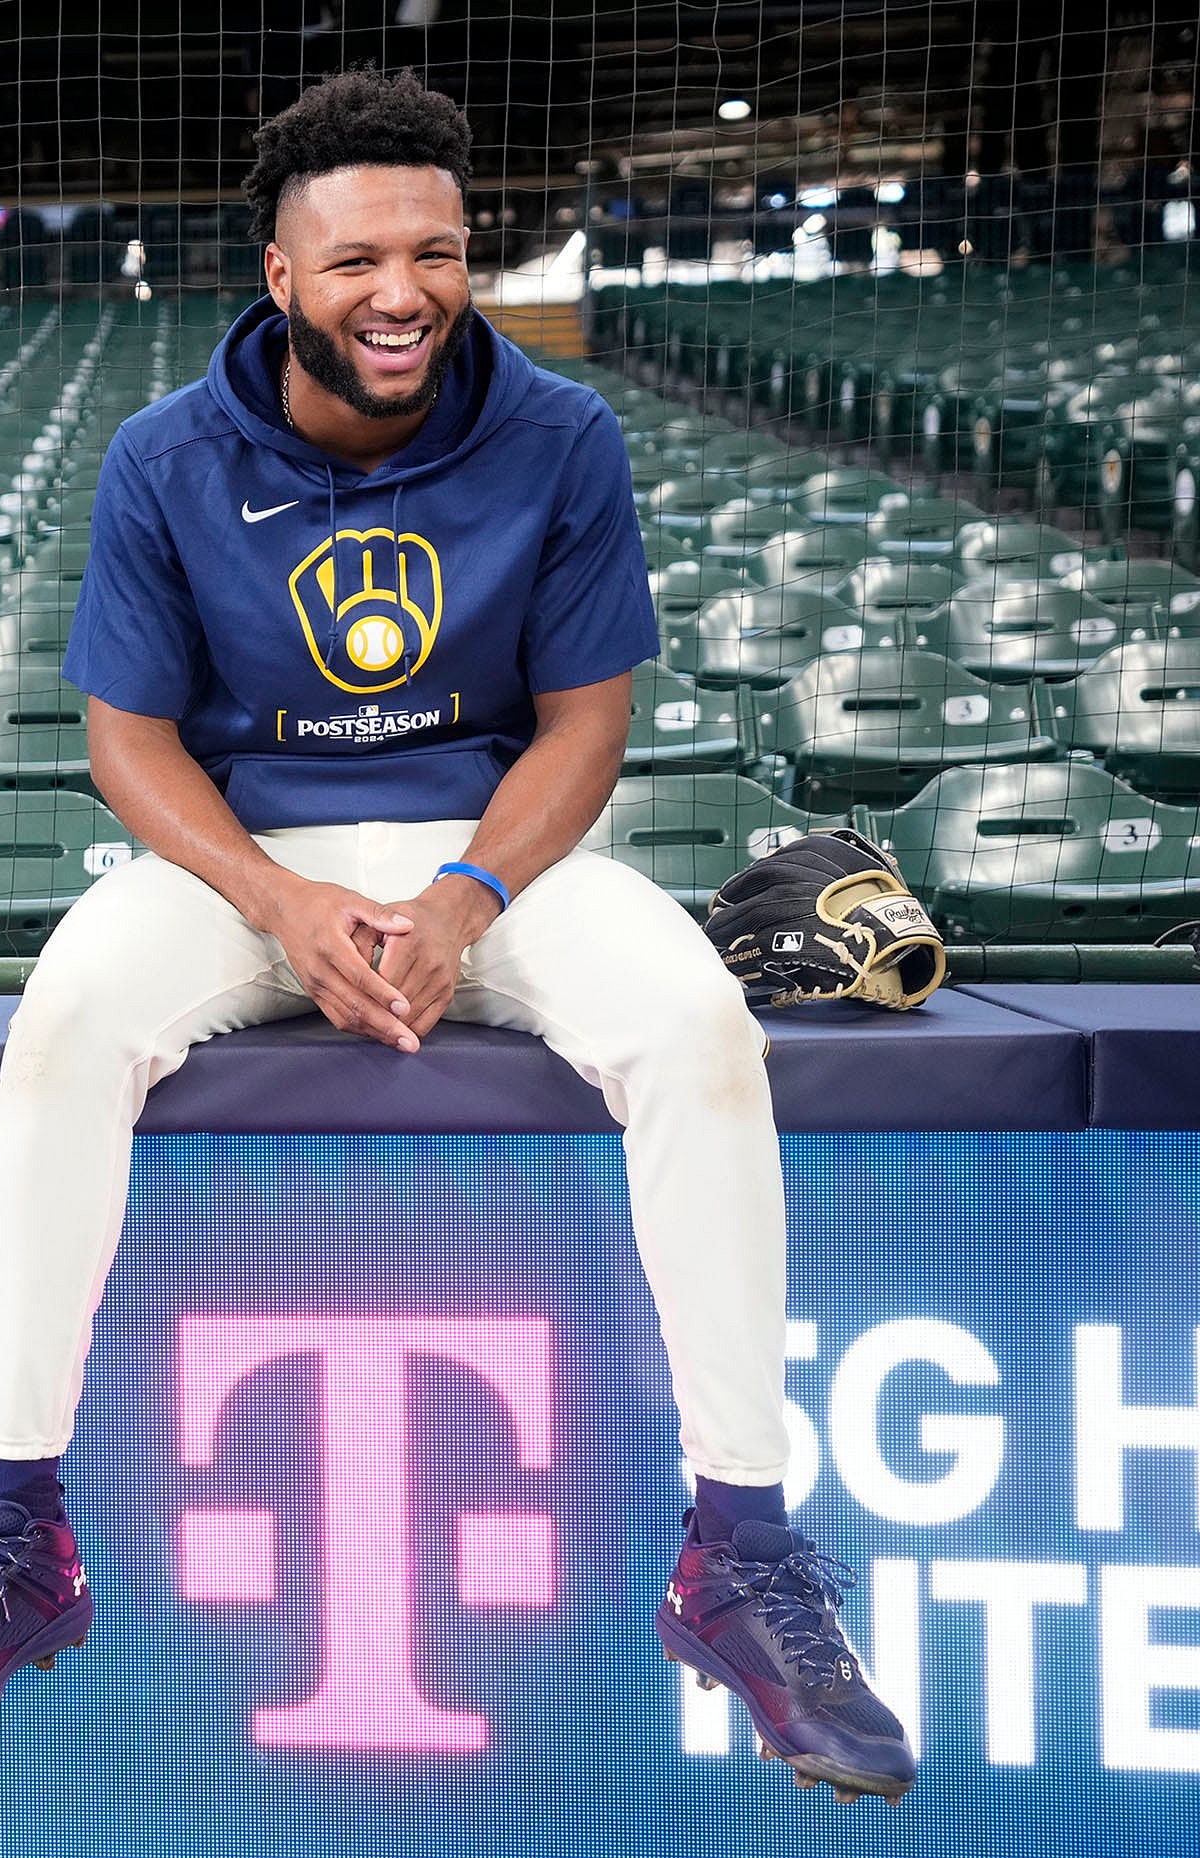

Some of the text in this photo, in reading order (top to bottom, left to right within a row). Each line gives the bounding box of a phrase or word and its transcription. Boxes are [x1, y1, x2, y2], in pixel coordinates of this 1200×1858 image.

[960, 700, 972, 718] 3
[297, 709, 441, 737] POSTSEASON
[353, 735, 385, 743] 2024
[1122, 823, 1138, 845] 3
[102, 850, 114, 868] 6
[179, 1315, 554, 1752] T
